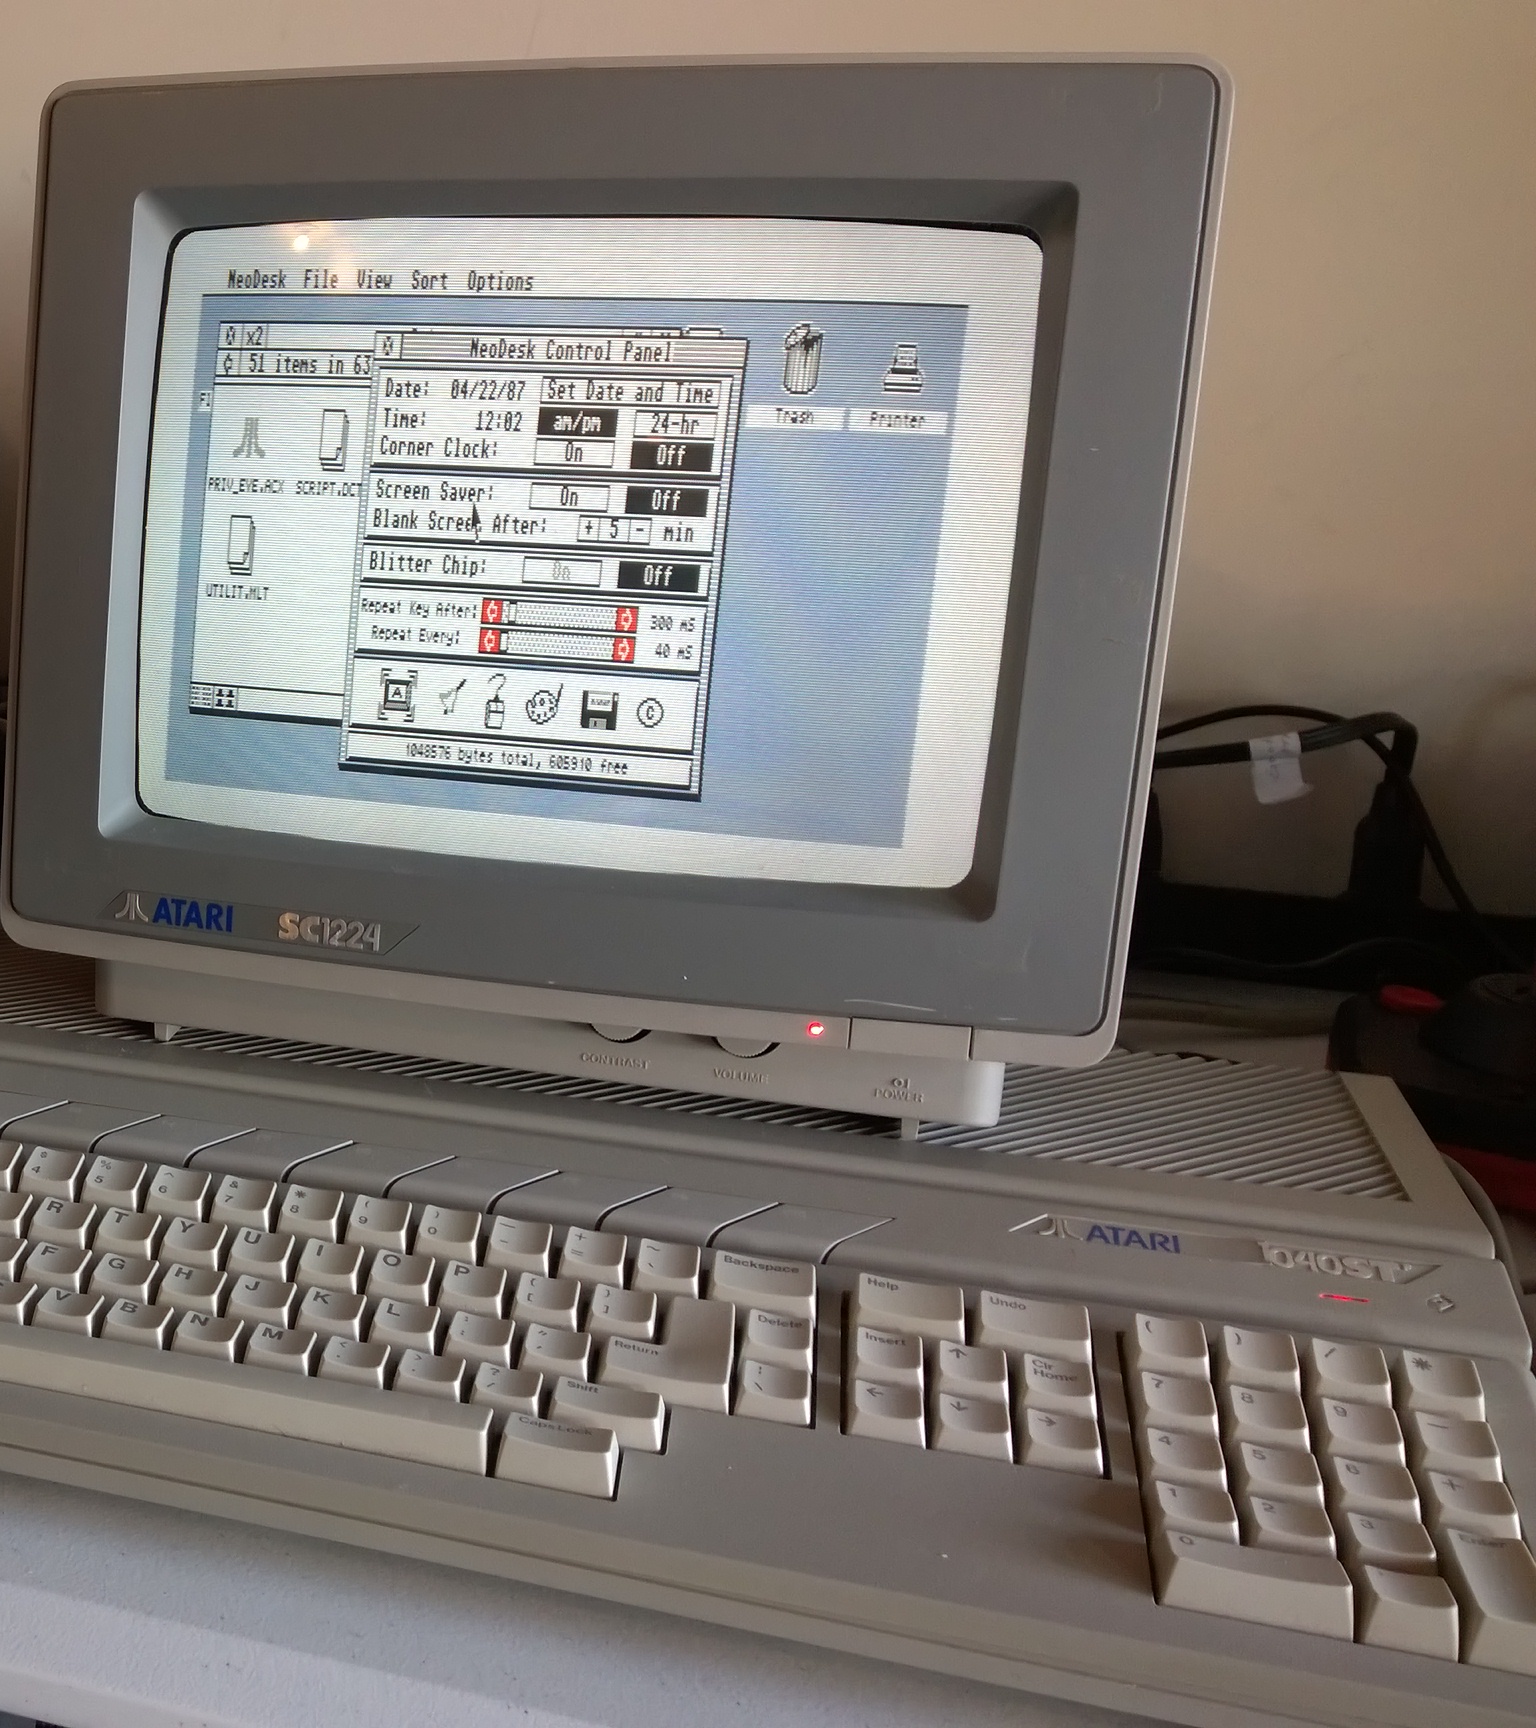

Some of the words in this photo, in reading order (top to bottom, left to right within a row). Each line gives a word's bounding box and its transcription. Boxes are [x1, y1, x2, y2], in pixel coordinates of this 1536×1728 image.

[227, 269, 287, 289] NeoDesk
[304, 269, 338, 289] File
[357, 270, 392, 289] View
[411, 271, 448, 290] Sort
[467, 272, 534, 292] Options
[246, 329, 263, 346] x2
[470, 338, 535, 359] NeoDesk
[545, 339, 612, 361] Control
[623, 341, 671, 362] Panel
[248, 354, 265, 373] 51
[275, 354, 317, 374] items
[328, 355, 344, 374] in
[385, 378, 429, 399] Date:
[450, 379, 526, 400] 04/22/87
[547, 379, 575, 399] Set
[586, 379, 624, 401] Date
[634, 381, 663, 402] and
[675, 381, 713, 403] Time
[383, 407, 426, 428] Time:
[475, 410, 522, 432] 12:02
[552, 411, 602, 434] am/pm
[776, 407, 814, 424] Trash
[870, 410, 925, 429] Printer
[651, 413, 699, 435] 24-hr
[379, 435, 434, 457] Corner
[444, 437, 498, 458] Clock:
[565, 440, 583, 461] On
[656, 444, 686, 466] Off
[376, 479, 430, 501] Screen
[440, 481, 493, 502] Saver:
[560, 486, 578, 506] On
[651, 489, 681, 511] Off
[372, 509, 419, 530] Blank
[492, 513, 547, 535] After:
[608, 518, 620, 539] 5
[663, 524, 694, 543] min
[369, 550, 432, 573] Blitter
[442, 552, 486, 576] Chip:
[643, 564, 673, 587] Off
[361, 599, 402, 615] Repeat
[409, 601, 430, 618] Key
[436, 603, 477, 619] After:
[650, 614, 673, 631] 300
[371, 625, 413, 643] Repeat
[418, 628, 460, 646] Every:
[654, 643, 671, 659] 40
[405, 744, 451, 759] 1048576
[458, 748, 493, 764] bytes
[501, 751, 541, 769] total,
[549, 755, 593, 772] 605910
[600, 759, 629, 775] free
[152, 897, 234, 932] ATARI
[278, 911, 381, 952] SC1224
[579, 1052, 651, 1071] CONTRAST
[712, 1066, 770, 1083] VOLUME
[873, 1087, 925, 1103] POWER
[31, 1165, 41, 1174] 4
[94, 1175, 103, 1184] 5
[158, 1184, 168, 1194] 6
[45, 1200, 64, 1214] R
[224, 1195, 233, 1203] 7
[289, 1204, 299, 1213] 8
[114, 1211, 129, 1224] T
[358, 1215, 368, 1224] 9
[180, 1220, 196, 1234] Y
[427, 1226, 438, 1235] 0
[243, 1231, 262, 1245] U
[1086, 1224, 1181, 1254] ATARI
[41, 1245, 59, 1257] F
[316, 1245, 324, 1257] I
[108, 1258, 126, 1270] G
[382, 1254, 402, 1267] O
[723, 1254, 800, 1275] Backspace
[174, 1267, 193, 1280] H
[454, 1265, 470, 1277] P
[245, 1280, 260, 1292] J
[867, 1275, 899, 1291] Help
[55, 1290, 72, 1302] V
[313, 1291, 331, 1305] K
[990, 1295, 1027, 1311] Undo
[119, 1301, 138, 1314] B
[386, 1303, 400, 1316] L
[190, 1315, 209, 1327] N
[757, 1313, 803, 1329] Delete
[261, 1327, 283, 1341] M
[865, 1331, 907, 1347] Insert
[614, 1338, 659, 1356] Return
[1033, 1369, 1078, 1383] Home
[1151, 1377, 1163, 1389] 7
[567, 1380, 600, 1395] Shift
[1240, 1392, 1253, 1404] 8
[1332, 1405, 1348, 1418] 9
[1157, 1434, 1172, 1446] 4
[1252, 1448, 1266, 1461] 5
[1168, 1487, 1177, 1498] 1
[1261, 1501, 1275, 1513] 2
